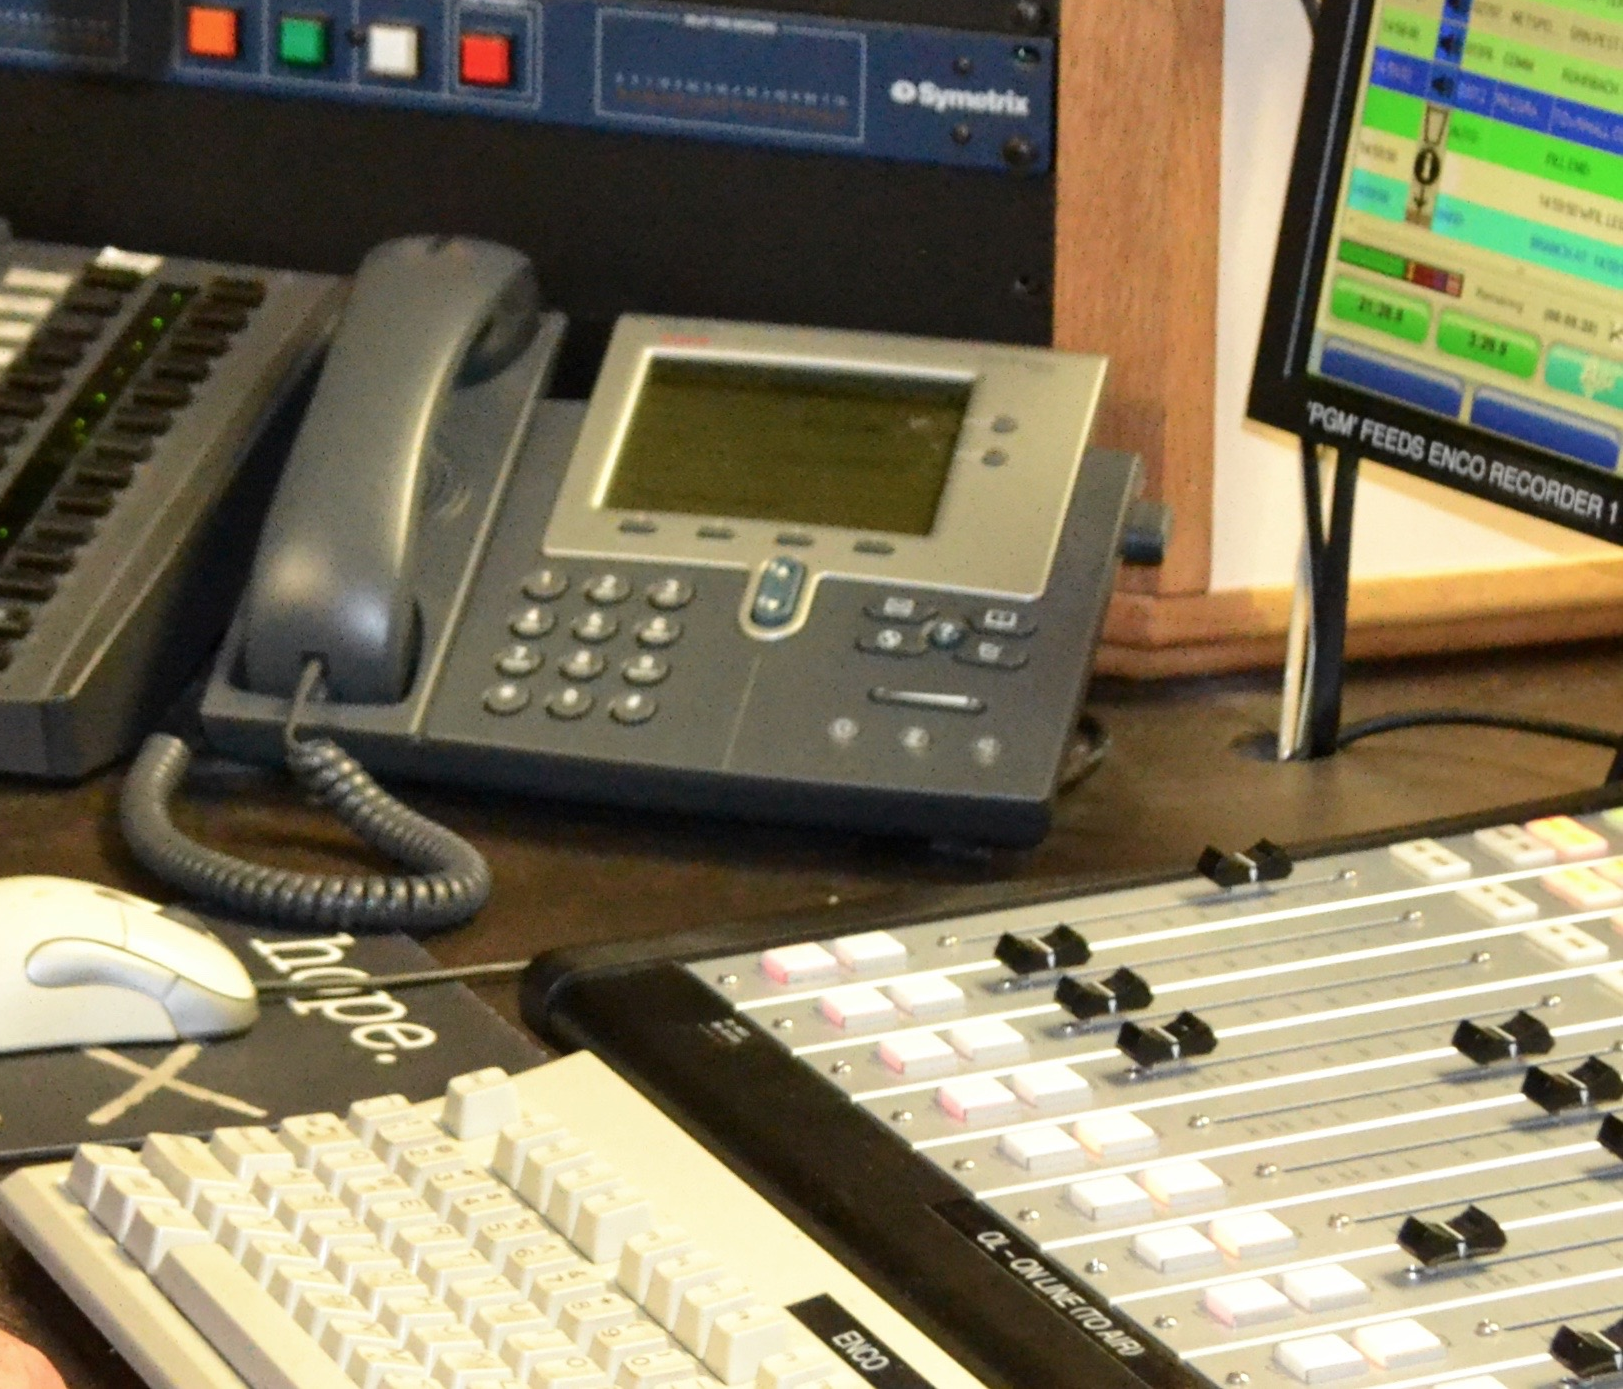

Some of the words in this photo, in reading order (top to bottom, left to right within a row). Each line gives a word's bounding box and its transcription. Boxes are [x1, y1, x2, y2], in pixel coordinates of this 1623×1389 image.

[917, 80, 1029, 118] Symetrix
[1358, 419, 1426, 461] FEEDS
[1427, 441, 1487, 480] ENCO
[1488, 461, 1605, 521] RECORDER
[1608, 500, 1619, 525] 1
[1010, 1257, 1045, 1290] ON
[1036, 1276, 1089, 1310] LINE
[1069, 1300, 1114, 1337] (TO
[1100, 1328, 1148, 1359] AIR)
[831, 1328, 890, 1372] ENCO
